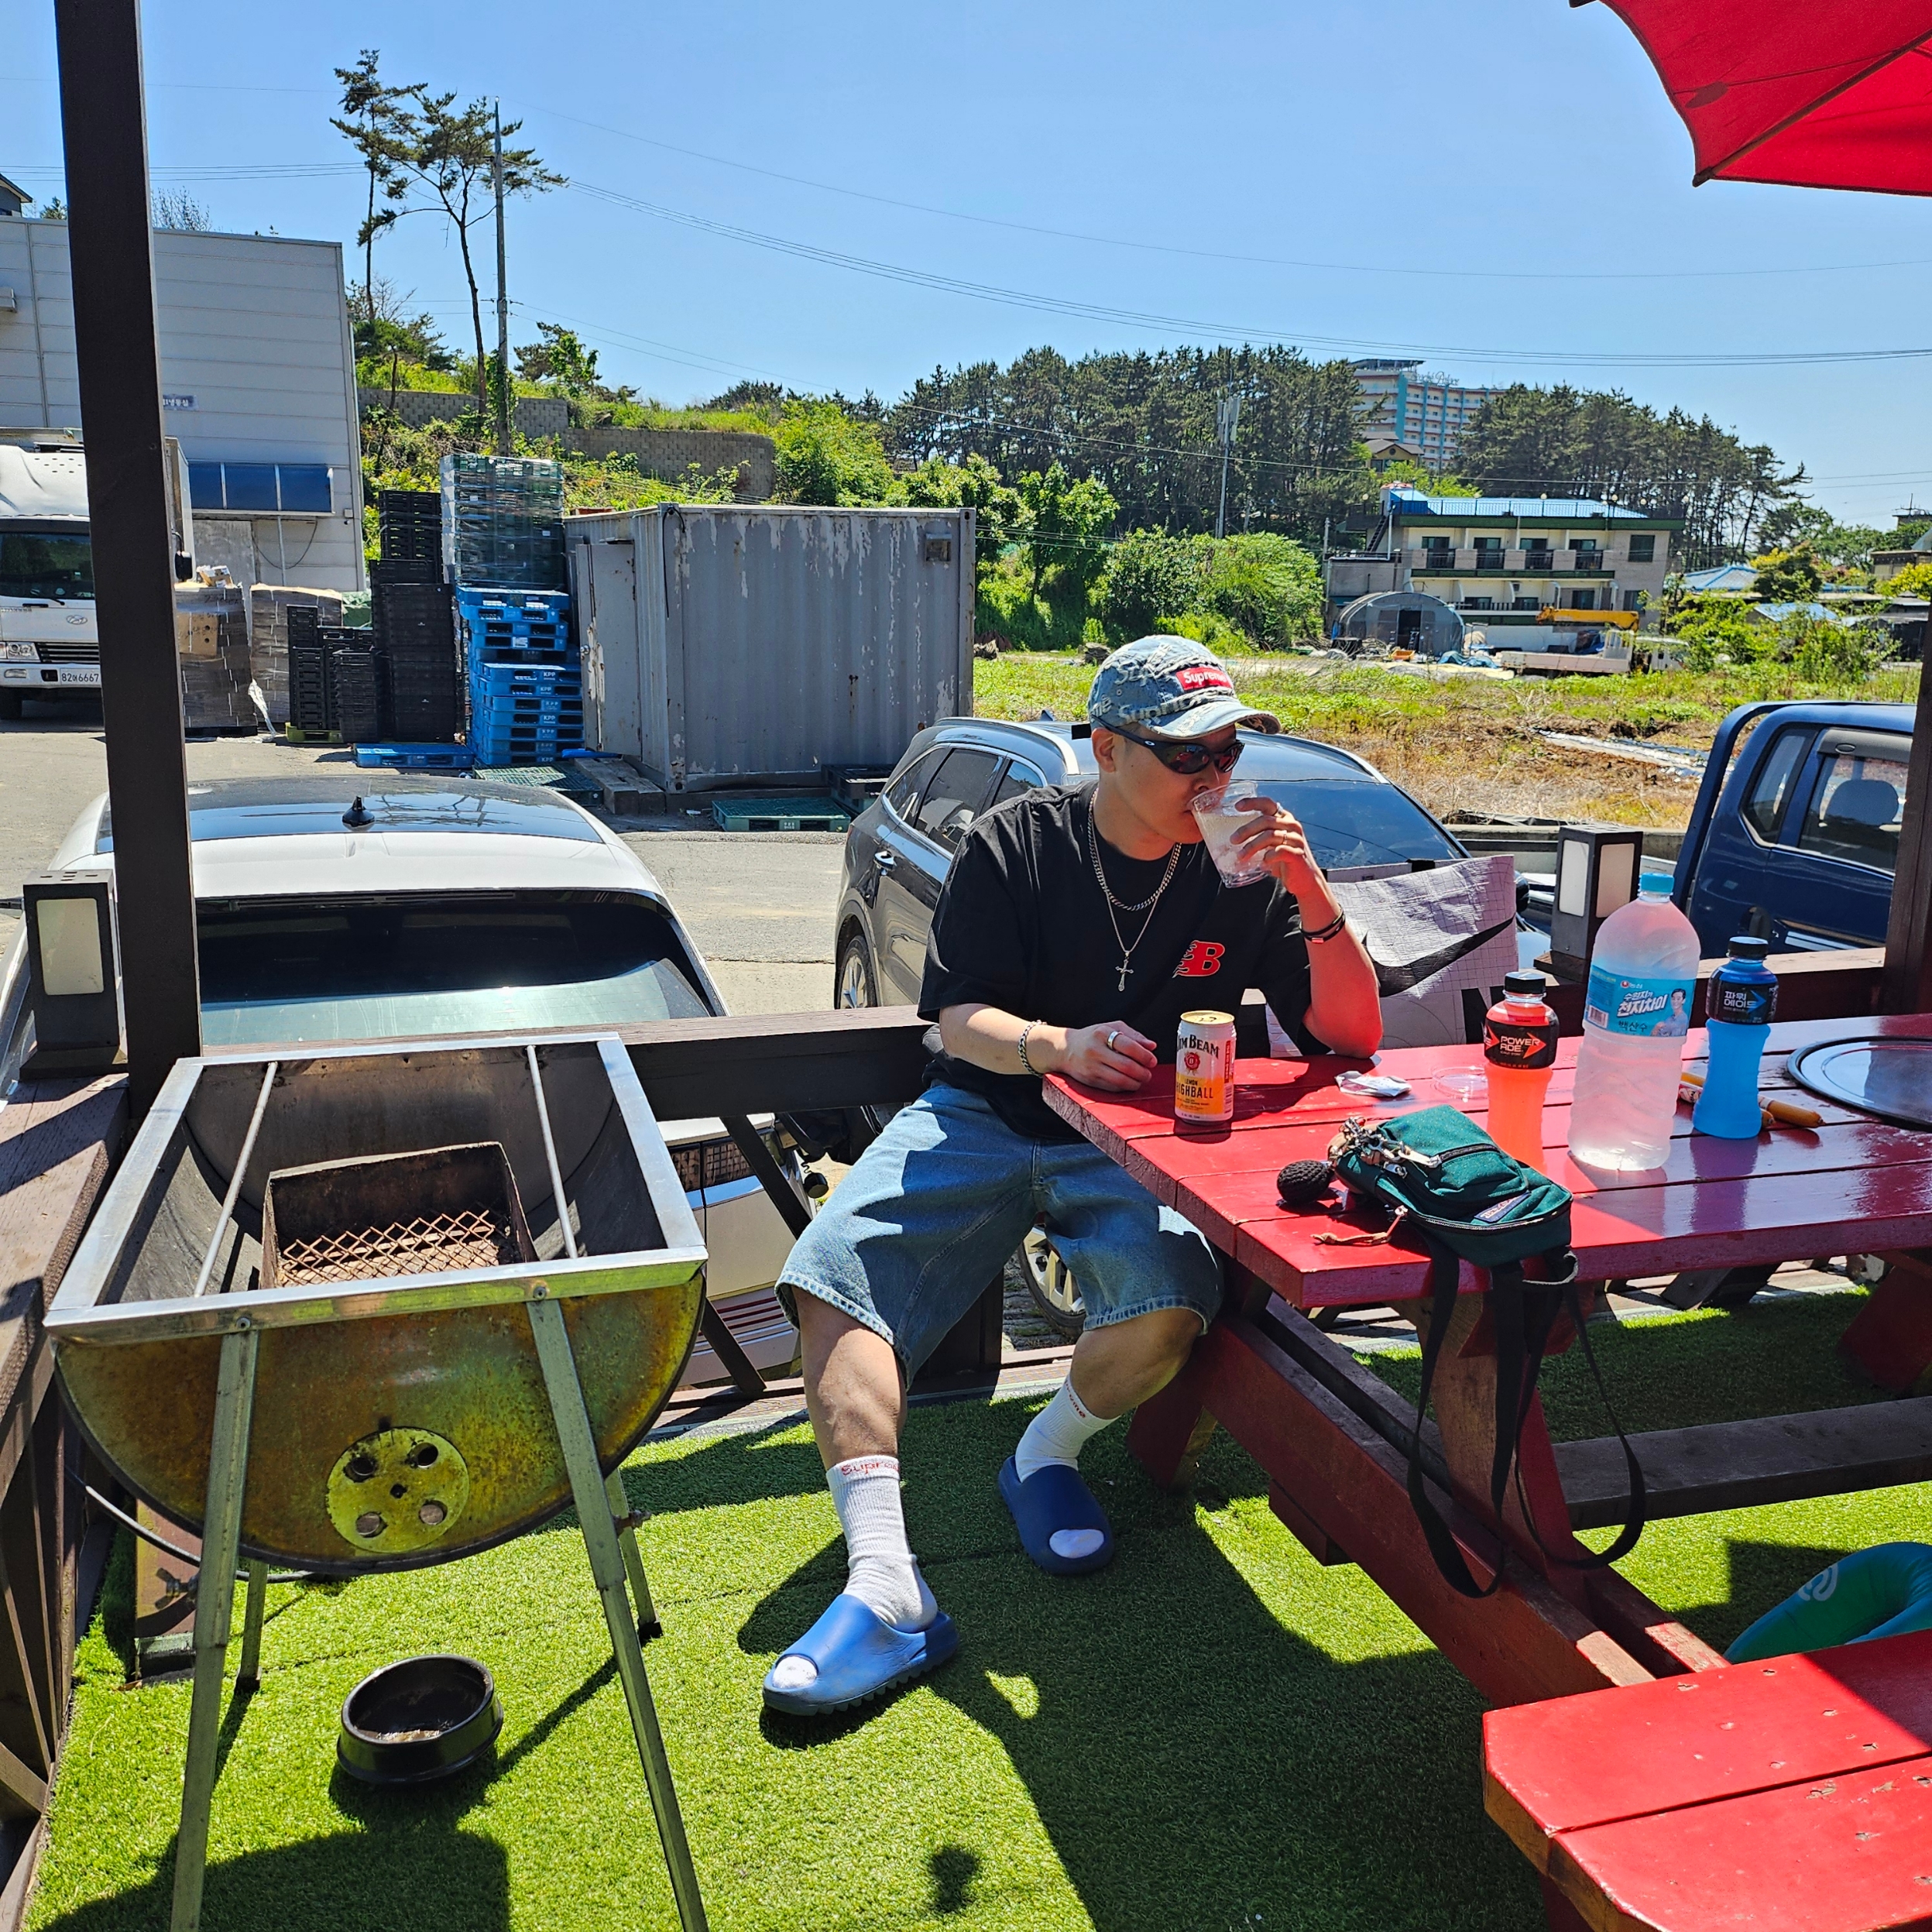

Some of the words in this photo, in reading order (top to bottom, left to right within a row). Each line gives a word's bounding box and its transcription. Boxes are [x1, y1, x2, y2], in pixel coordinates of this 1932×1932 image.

[1183, 671, 1227, 685] Supreme
[1724, 990, 1747, 1000] 파워
[1616, 993, 1669, 1017] 천지차이
[1723, 998, 1758, 1009] 에이드
[1618, 1021, 1648, 1033] 백산수
[1500, 1035, 1541, 1046] POWER
[1189, 1034, 1220, 1060] BEAM
[1500, 1043, 1522, 1052] ADE
